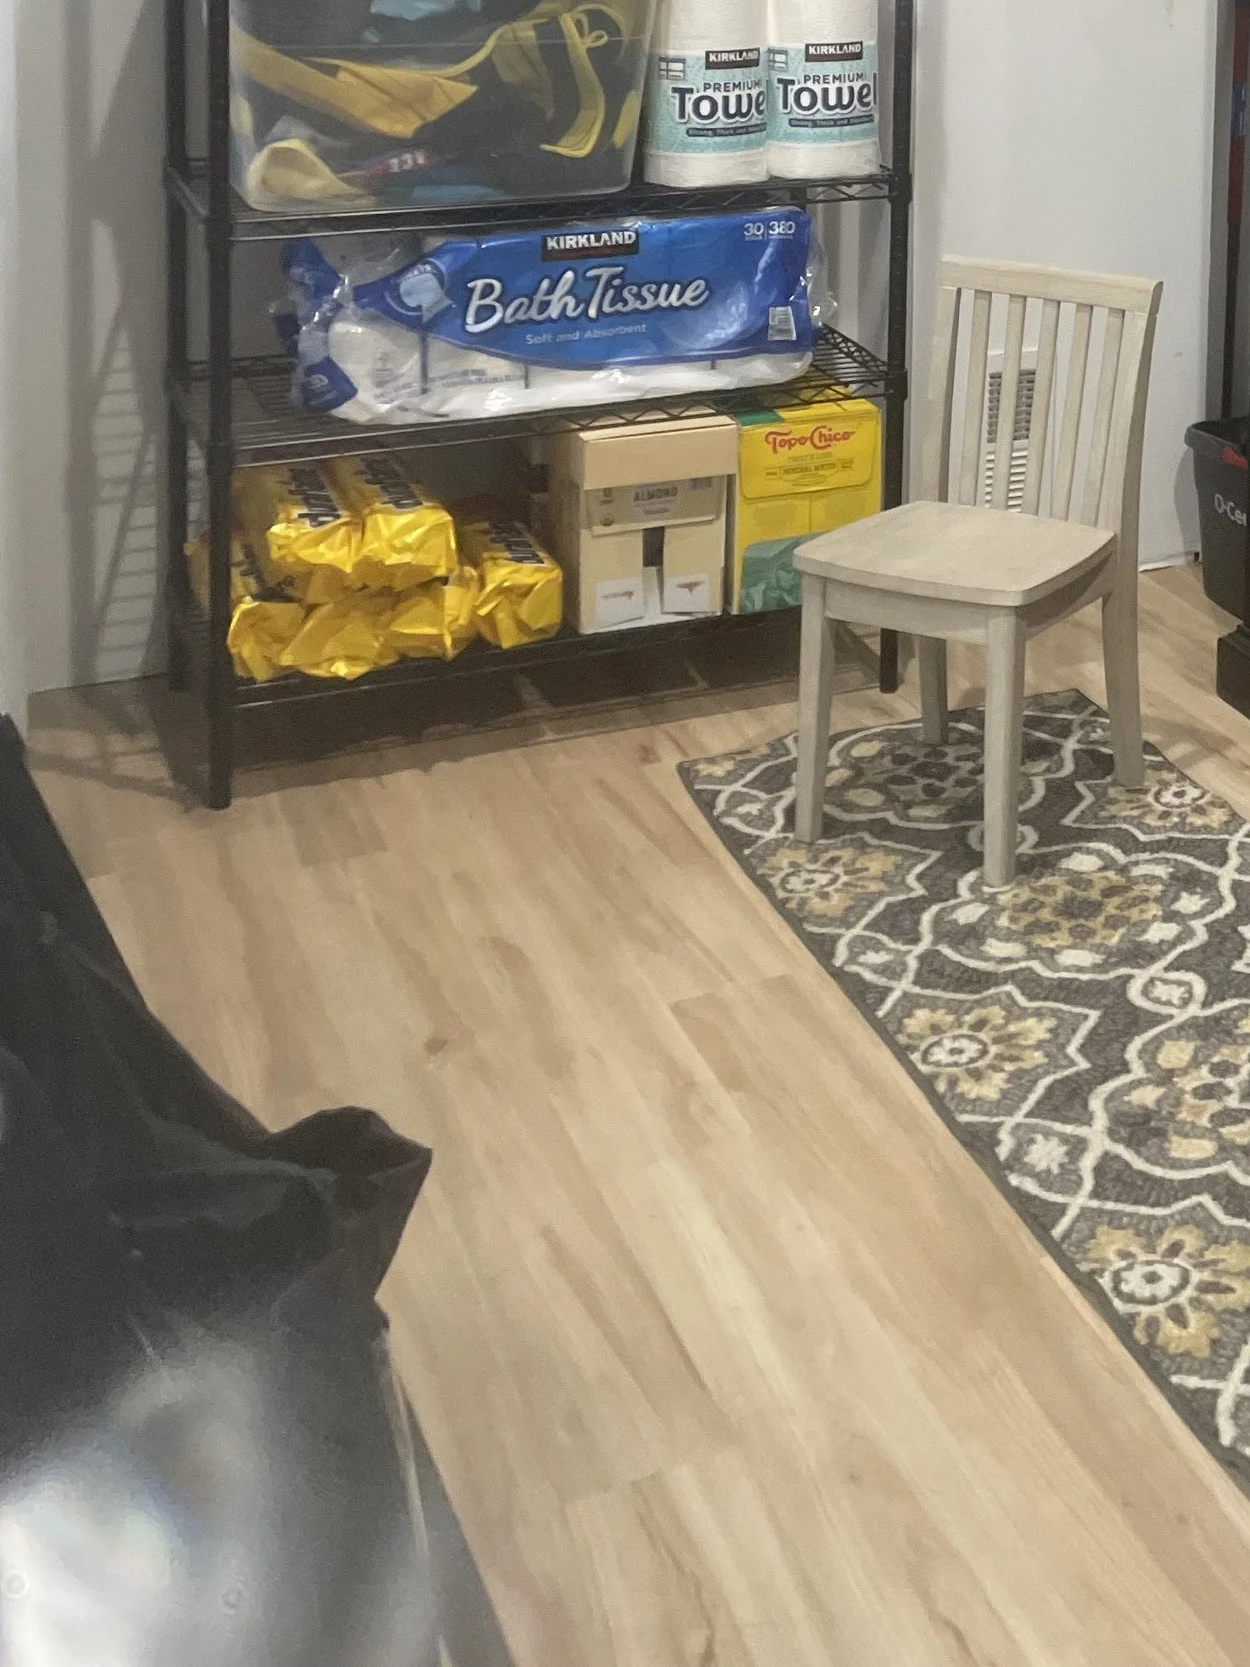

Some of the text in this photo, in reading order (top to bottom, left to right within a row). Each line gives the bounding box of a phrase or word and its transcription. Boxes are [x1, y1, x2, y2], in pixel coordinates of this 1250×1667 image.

[708, 49, 759, 63] KIRKLAND
[808, 43, 862, 55] KIRKLAND
[803, 72, 864, 84] PREMIUM
[743, 220, 796, 236] 30 380
[546, 230, 636, 251] KIRKLAND
[464, 266, 709, 333] Bath Tissue
[556, 329, 580, 342] and
[764, 425, 856, 454] Topo Chico
